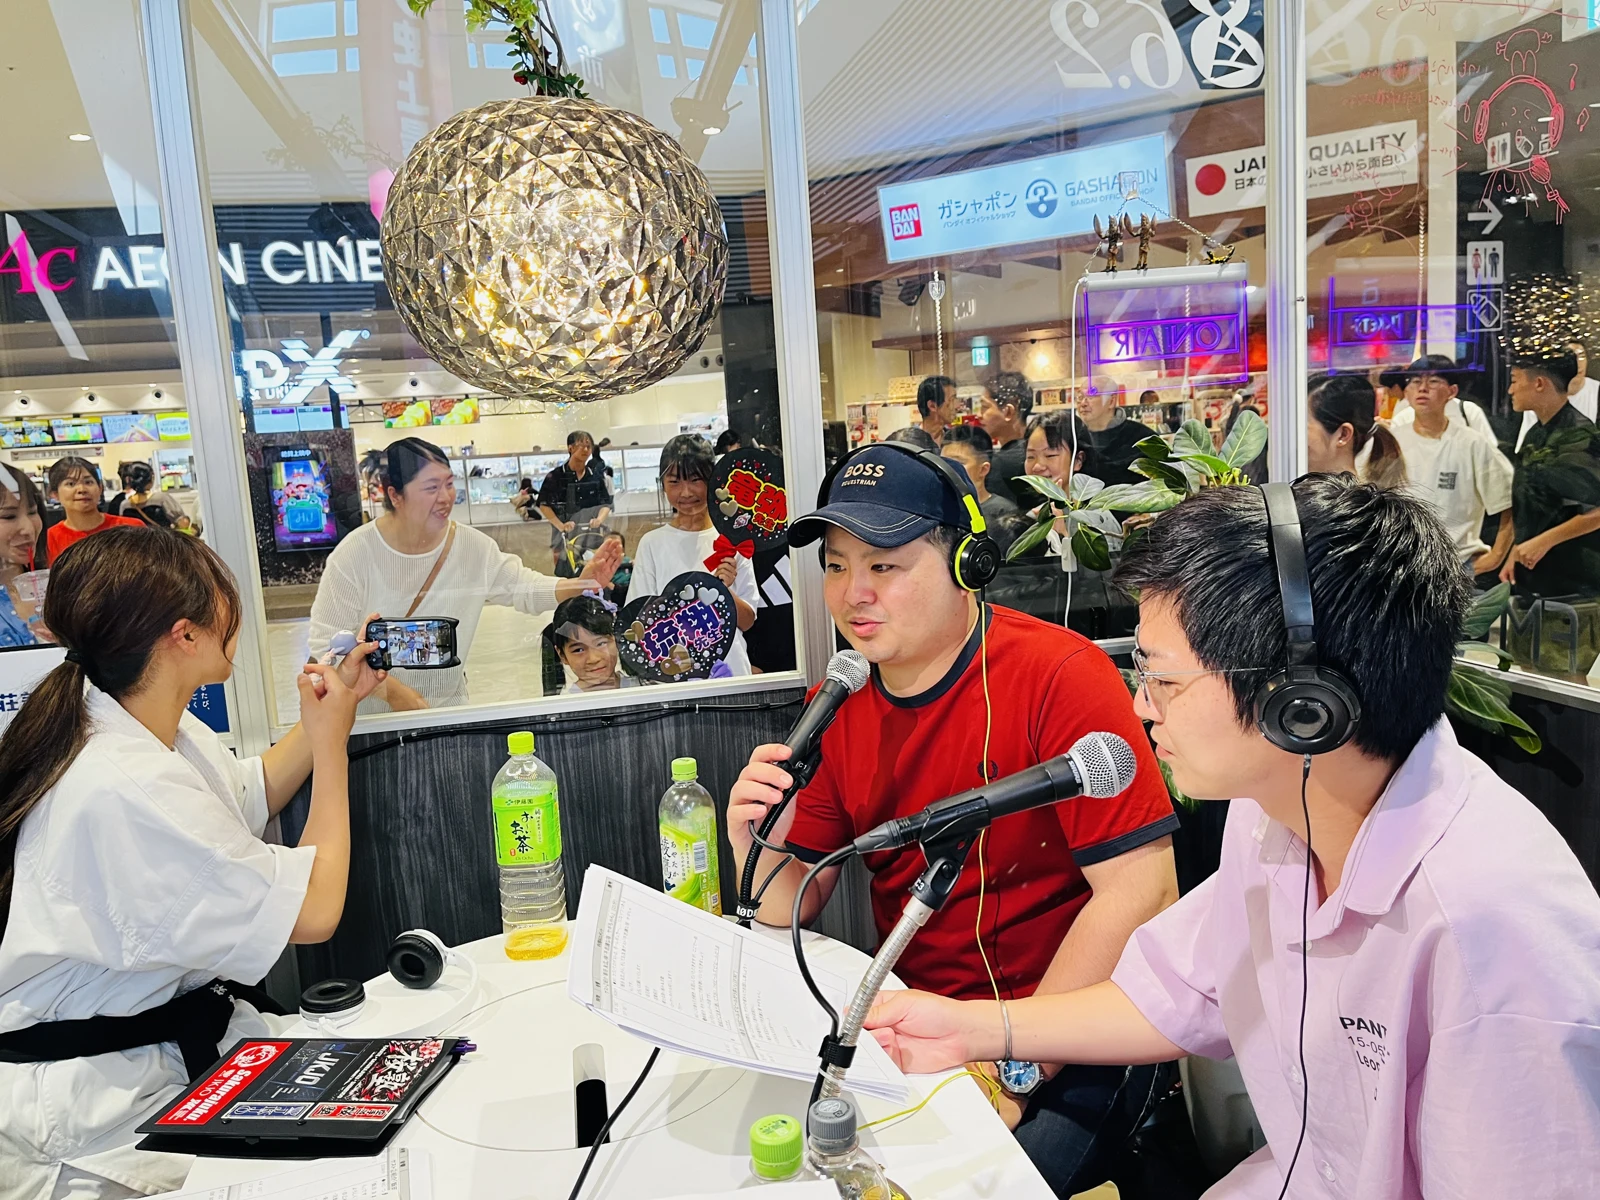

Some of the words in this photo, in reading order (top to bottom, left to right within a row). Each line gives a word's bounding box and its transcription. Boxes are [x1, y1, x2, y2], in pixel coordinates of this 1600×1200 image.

[1309, 131, 1407, 161] QUALITY
[1306, 153, 1407, 179] 小さいから面白い
[891, 207, 919, 224] BAN
[938, 190, 1017, 220] ガシャポン
[894, 221, 915, 237] DAI
[92, 243, 248, 291] AEN
[844, 463, 886, 479] BOSS
[294, 1052, 341, 1086] JKJO
